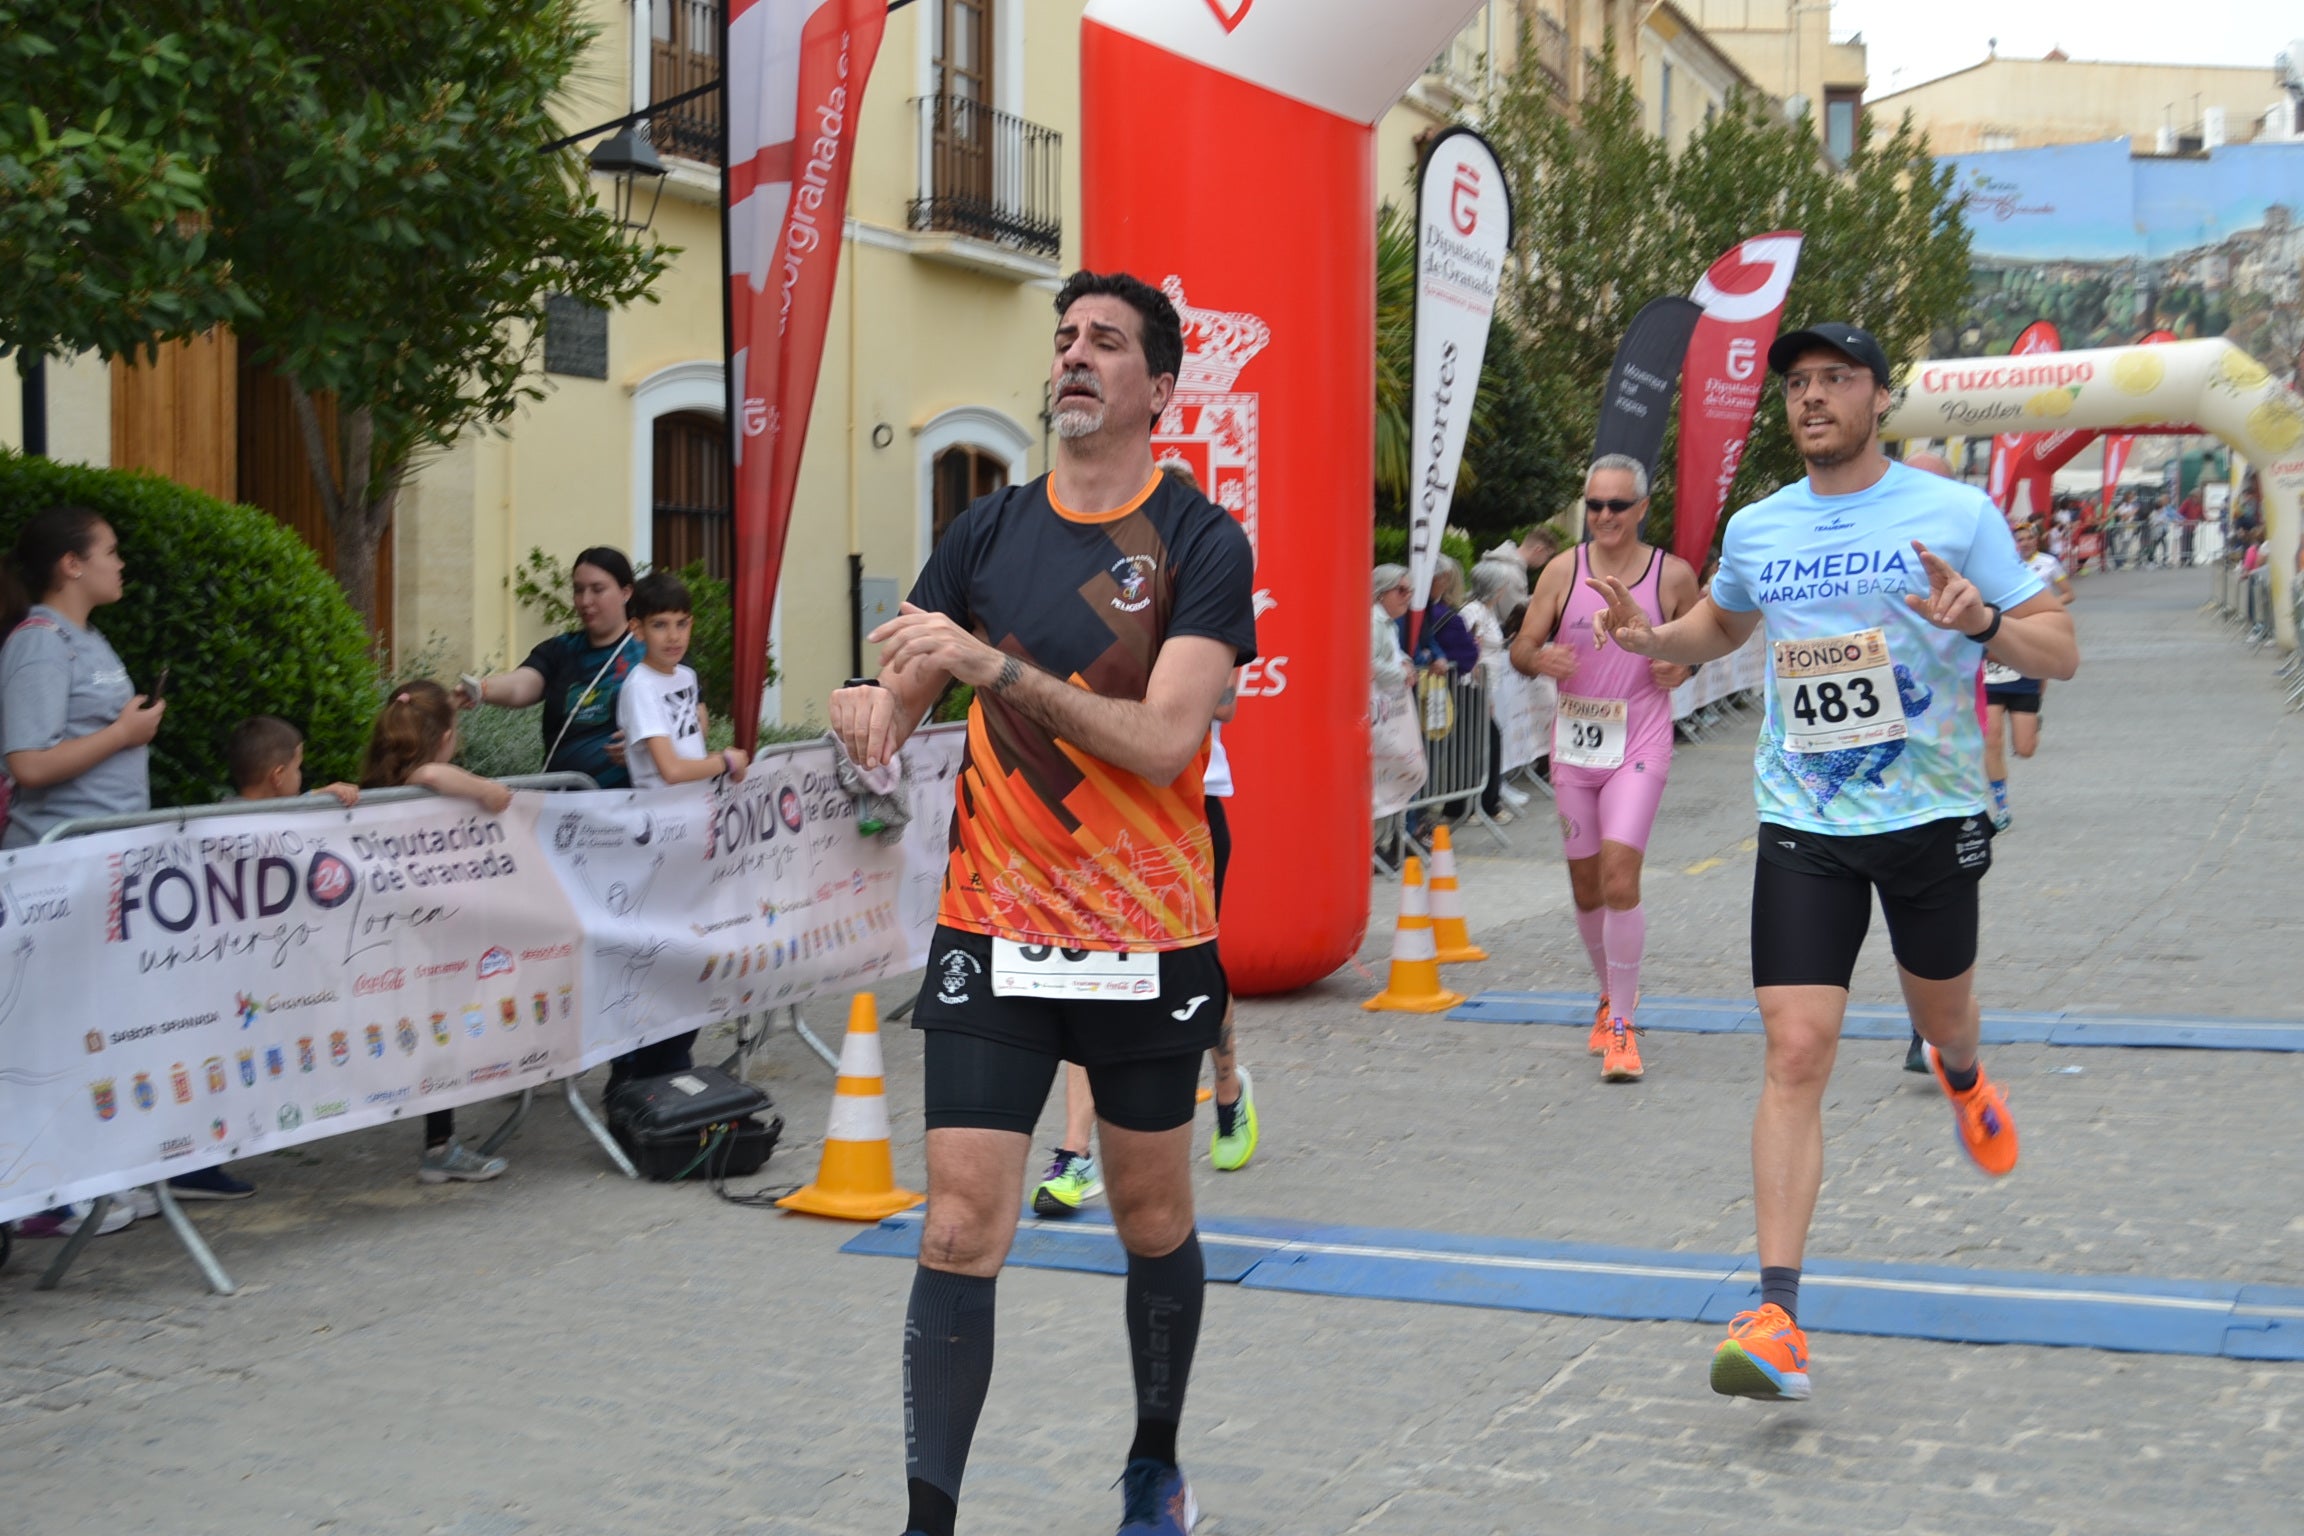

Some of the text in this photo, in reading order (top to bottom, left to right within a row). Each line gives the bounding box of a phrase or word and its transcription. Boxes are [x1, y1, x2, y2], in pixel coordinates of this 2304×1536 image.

[1922, 360, 2095, 394] Cruzcampo
[1758, 577, 1909, 605] MARATÓN BAZA
[1788, 644, 1861, 669] FONDO
[1793, 676, 1880, 727] 483
[351, 816, 506, 862] Diputación
[368, 851, 517, 895] de Granada
[117, 850, 356, 943] FONDO
